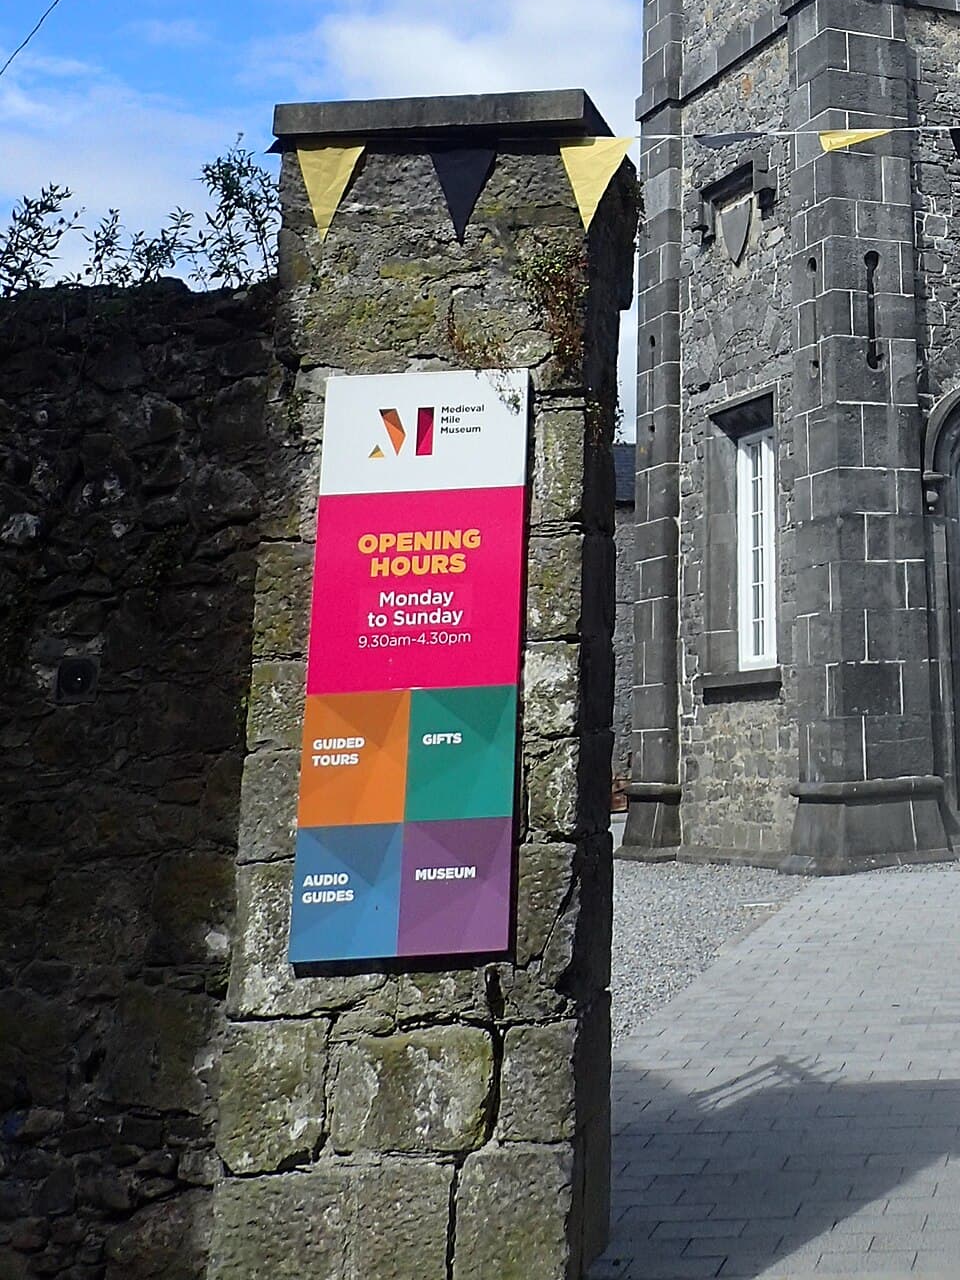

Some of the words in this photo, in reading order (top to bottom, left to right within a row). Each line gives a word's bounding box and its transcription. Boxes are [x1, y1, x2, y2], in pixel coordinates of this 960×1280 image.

[441, 404, 484, 414] Medieval
[440, 416, 461, 424] Mile
[440, 426, 481, 434] Museum
[358, 528, 481, 554] OPENING
[370, 553, 466, 577] HOURS
[379, 589, 454, 607] Monday
[368, 612, 388, 627] to
[393, 608, 463, 626] Sunday
[358, 631, 472, 648] 9.30am-4.30pm
[313, 737, 365, 751] GUIDED
[422, 733, 462, 746] GIFTS
[312, 753, 359, 767] TOURS
[303, 873, 348, 887] AUDIO
[415, 866, 476, 881] MUSEUM
[302, 890, 354, 904] GUIDES
